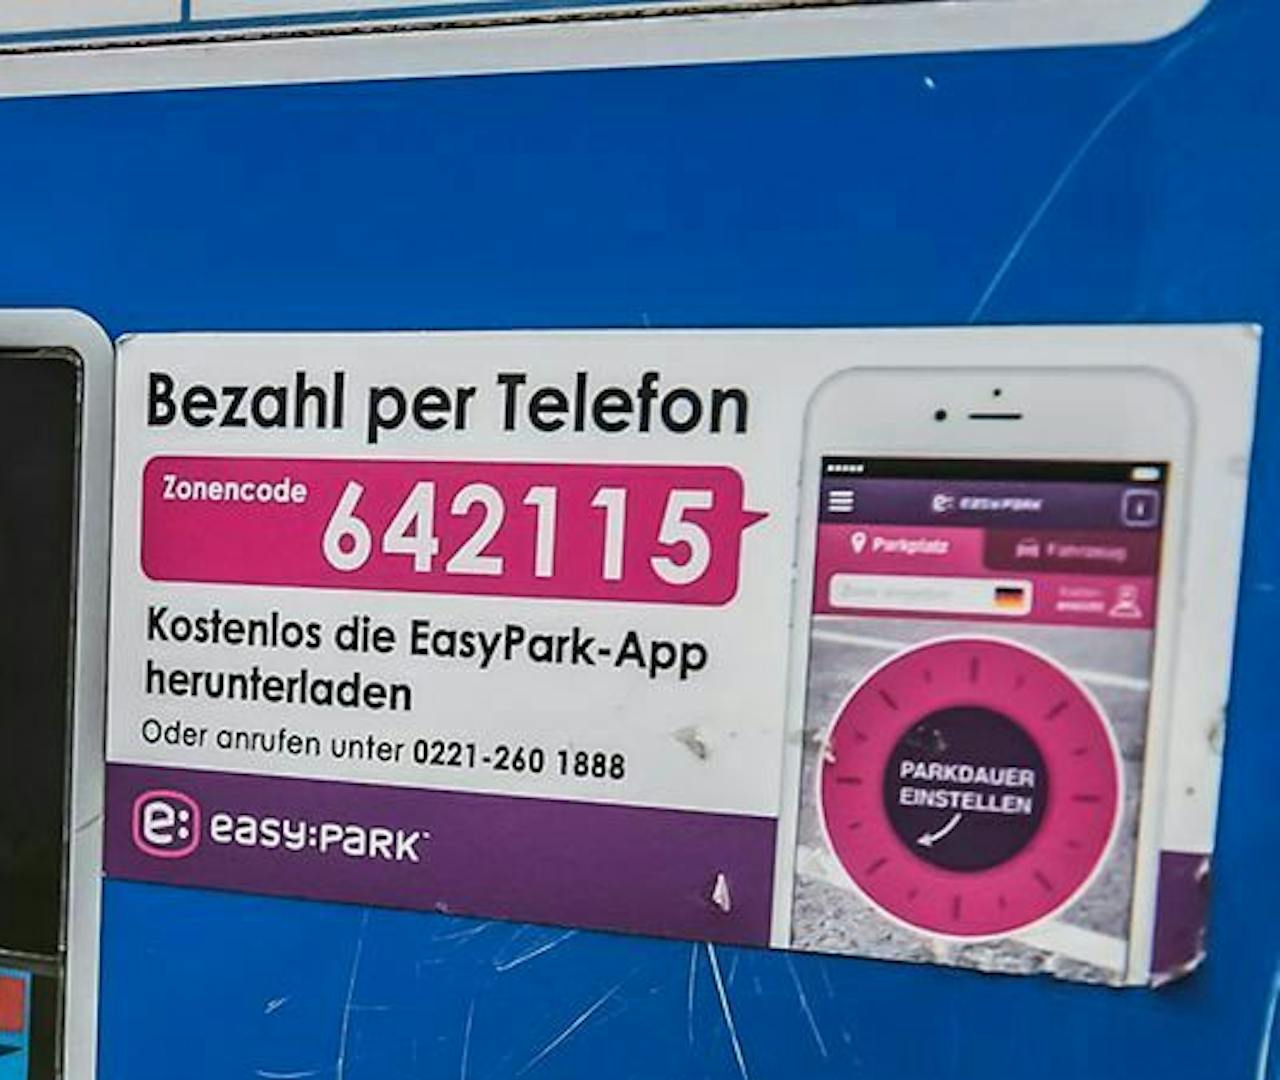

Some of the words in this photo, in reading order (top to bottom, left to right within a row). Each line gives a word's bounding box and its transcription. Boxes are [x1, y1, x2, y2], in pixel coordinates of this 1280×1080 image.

[147, 371, 345, 431] Bezahl
[367, 383, 476, 443] per
[496, 372, 749, 434] Telefon
[162, 474, 308, 503] Zonencode
[322, 480, 716, 586] 642115
[872, 536, 950, 555] Parkplatz
[146, 606, 321, 651] Kostenlos
[334, 615, 396, 654] die
[410, 619, 709, 681] EasyPark-App
[145, 660, 413, 711] herunterladen
[142, 718, 207, 748] Oder
[216, 726, 320, 758] anrufen
[331, 736, 404, 764] unter
[413, 738, 545, 774] 0221-260
[558, 749, 626, 780] 1888
[899, 760, 1035, 788] PARKDAUER
[899, 786, 1032, 815] EINSTELLEN
